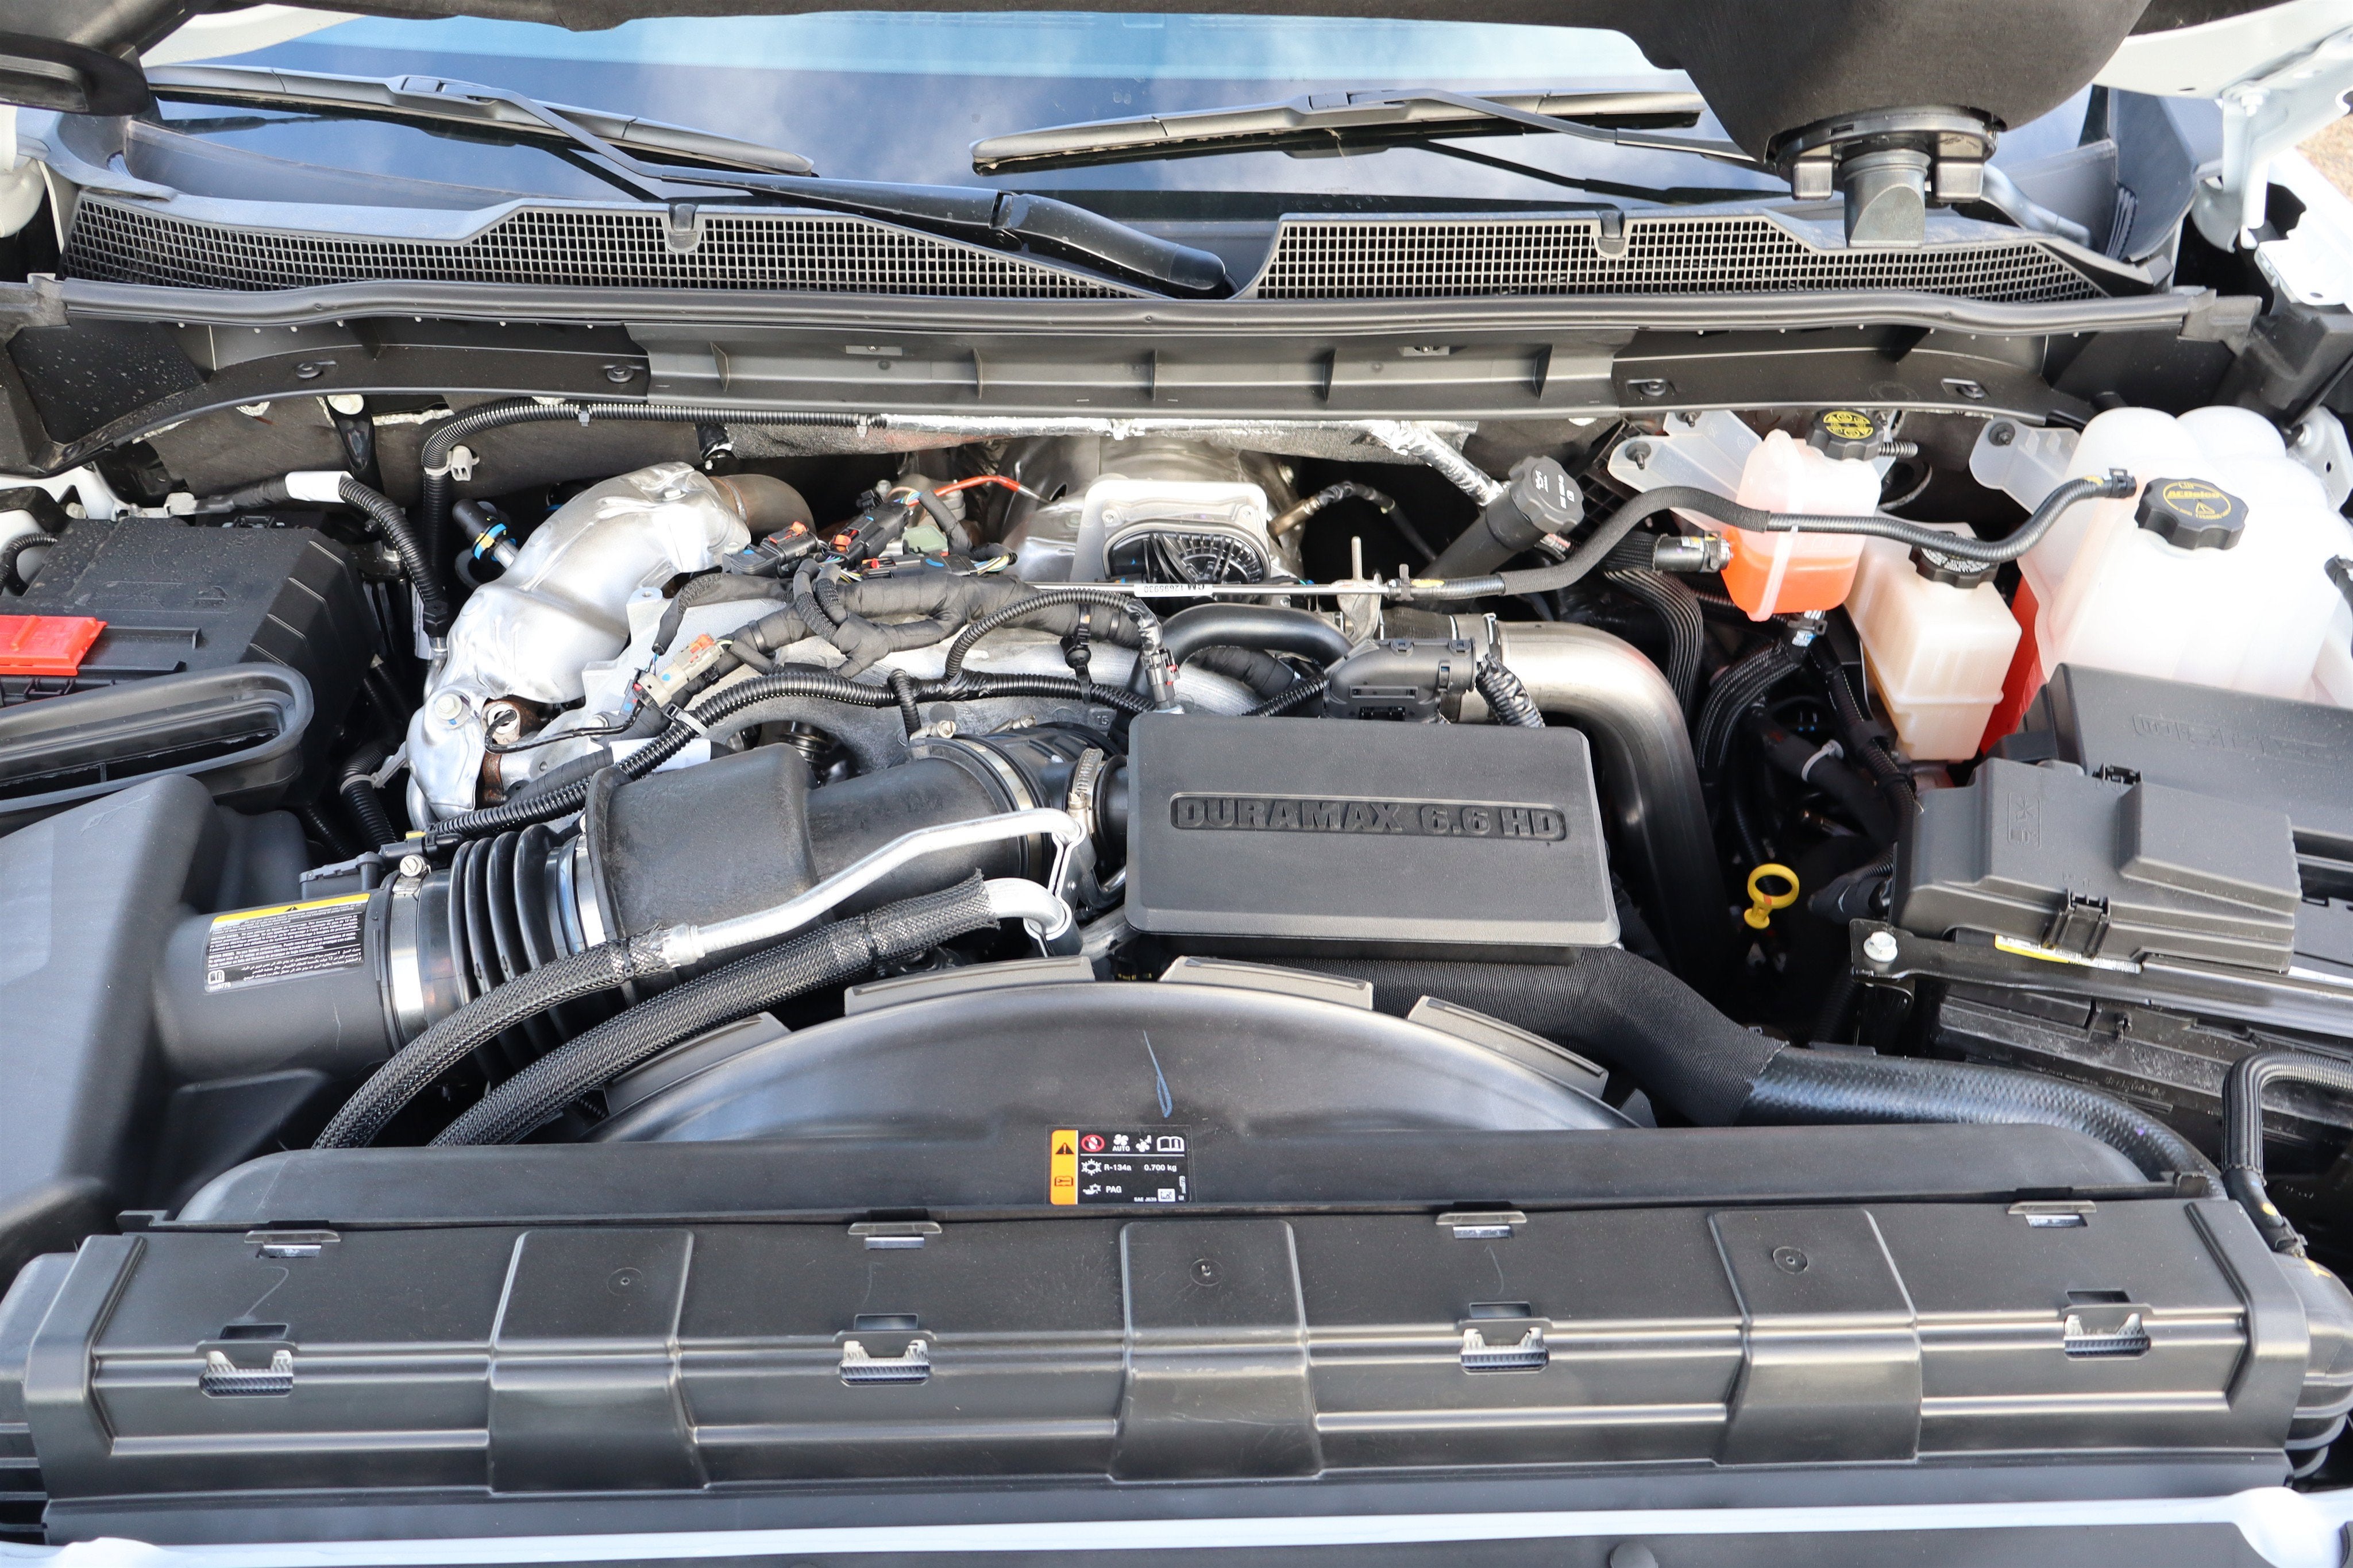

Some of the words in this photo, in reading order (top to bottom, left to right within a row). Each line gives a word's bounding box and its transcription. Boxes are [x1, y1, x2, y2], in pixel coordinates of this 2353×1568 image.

[1178, 798, 1402, 831] DURAMAX
[1420, 805, 1489, 835] 6.6
[1503, 808, 1564, 839] HD
[1167, 1164, 1176, 1172] kg
